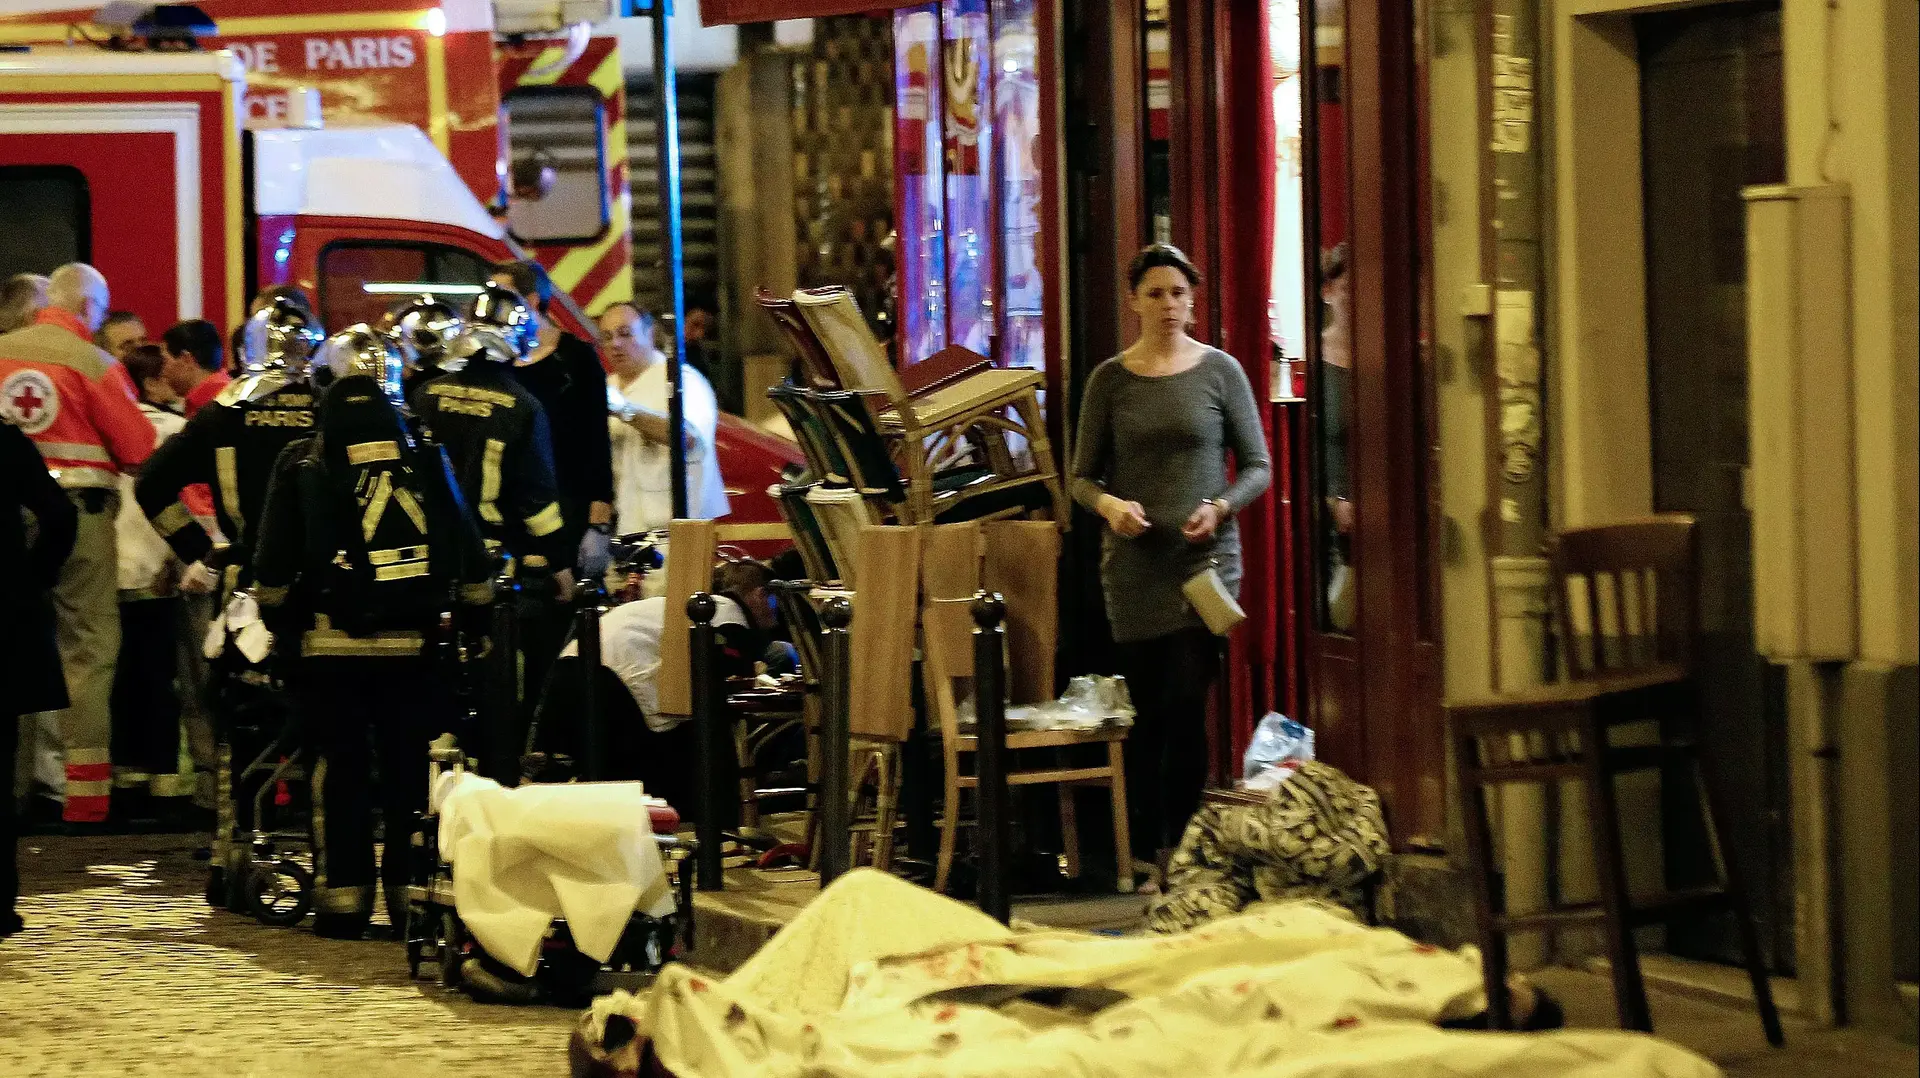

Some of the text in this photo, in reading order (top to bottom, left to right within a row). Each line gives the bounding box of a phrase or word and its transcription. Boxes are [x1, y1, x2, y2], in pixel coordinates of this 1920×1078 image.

[304, 37, 416, 71] PARIS
[244, 410, 315, 428] PARIS
[438, 396, 494, 419] PARIS
